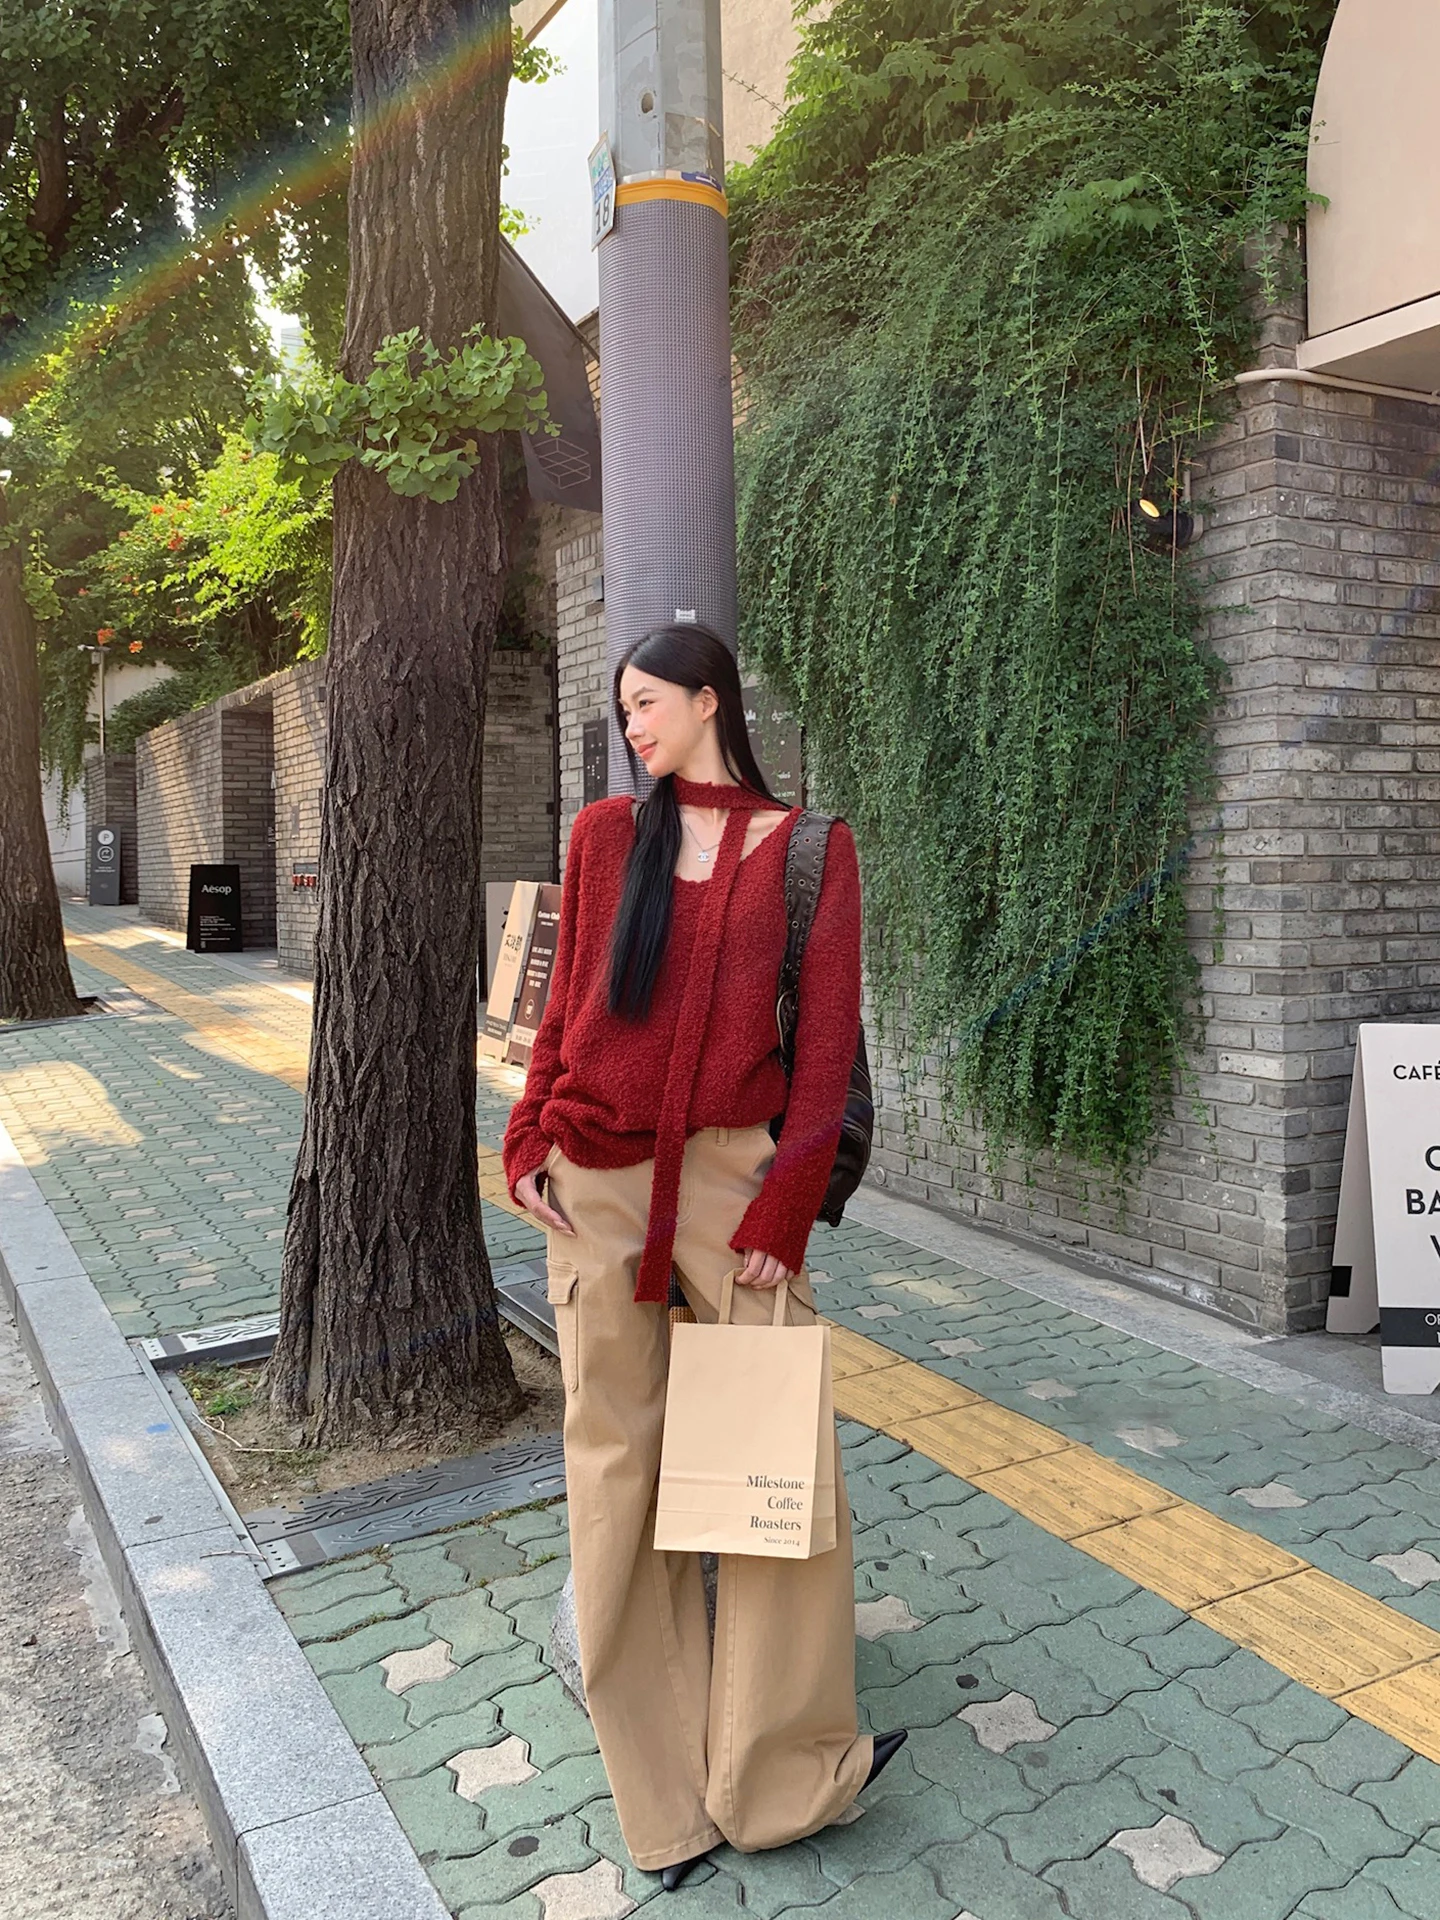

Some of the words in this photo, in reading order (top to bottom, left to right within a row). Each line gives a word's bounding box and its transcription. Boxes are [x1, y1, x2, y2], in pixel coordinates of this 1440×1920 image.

[595, 193, 610, 236] 18
[201, 884, 232, 896] Aesop
[746, 1475, 805, 1490] Milestone
[767, 1495, 804, 1511] Coffee
[749, 1515, 802, 1531] Roasters
[764, 1536, 782, 1545] Since
[783, 1539, 800, 1547] 2014
